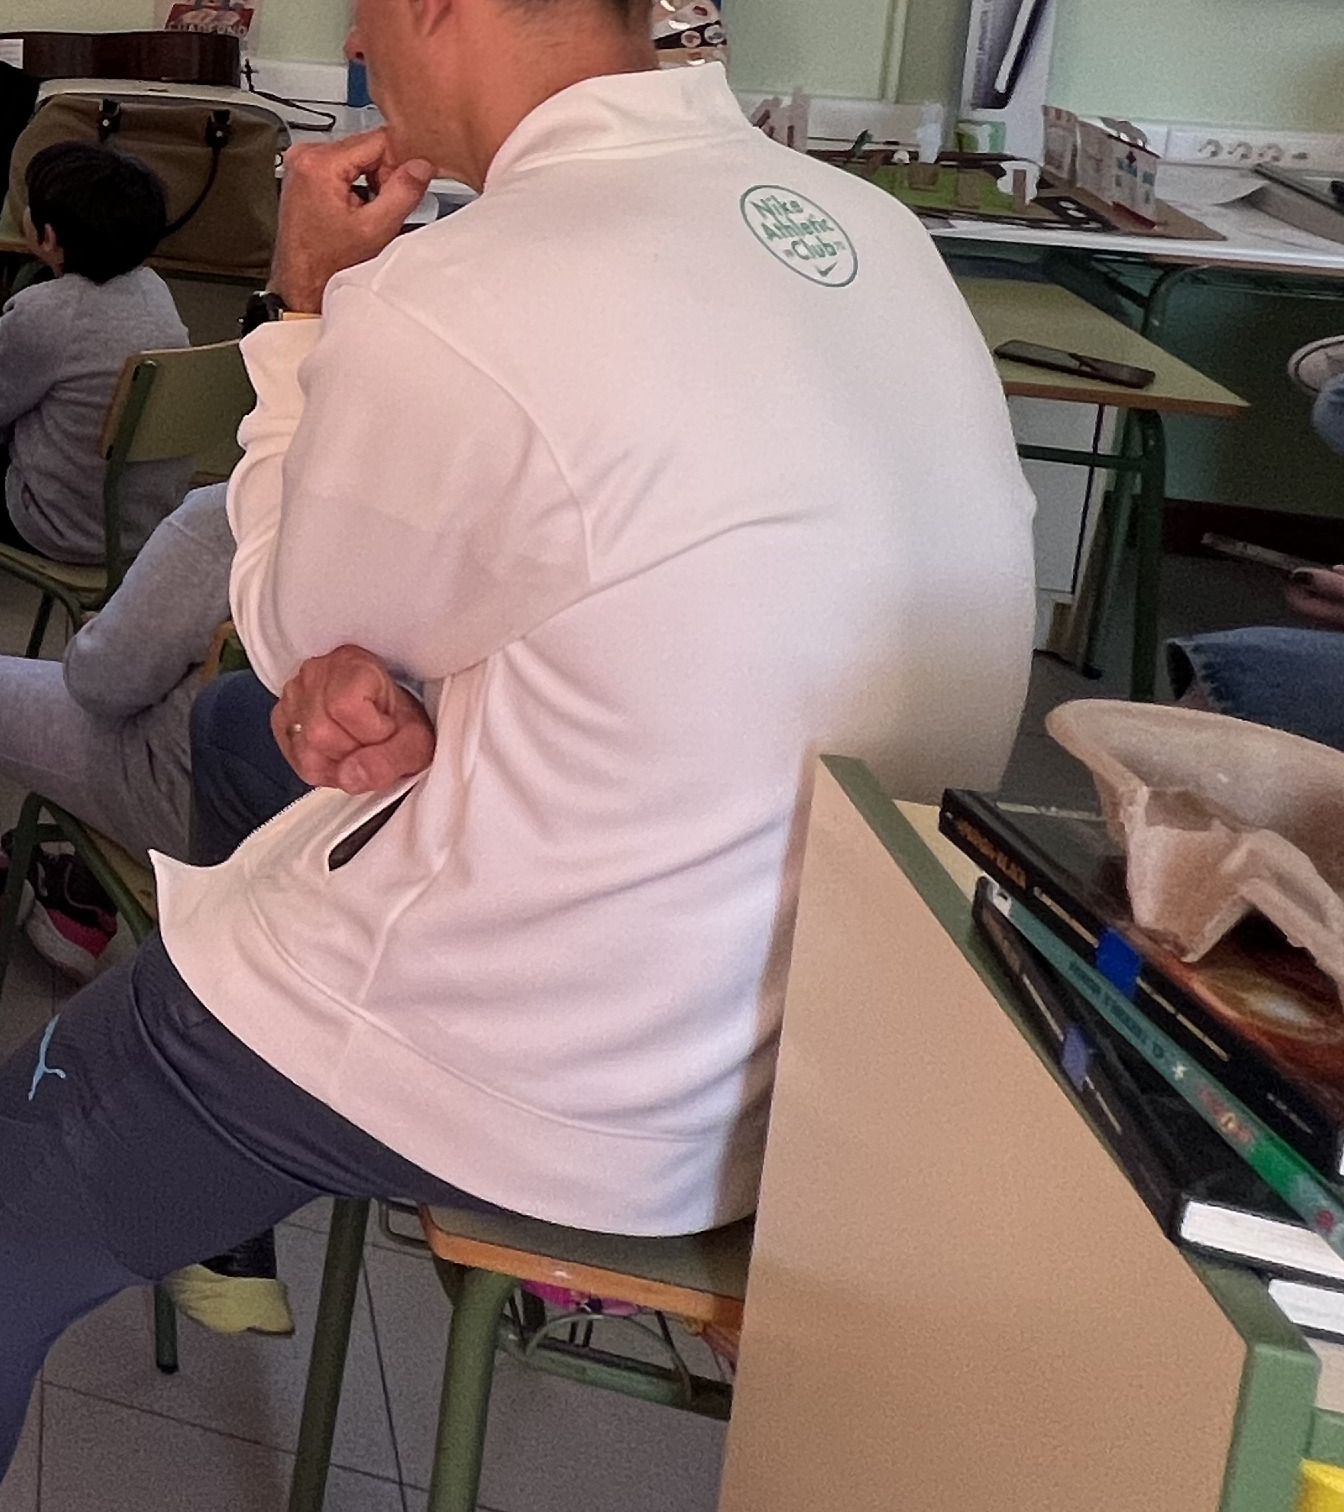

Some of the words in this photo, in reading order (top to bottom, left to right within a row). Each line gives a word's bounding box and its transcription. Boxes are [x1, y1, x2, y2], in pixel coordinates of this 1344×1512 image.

[750, 194, 803, 219] Nike
[761, 213, 835, 241] Athletic
[791, 235, 837, 260] Club
